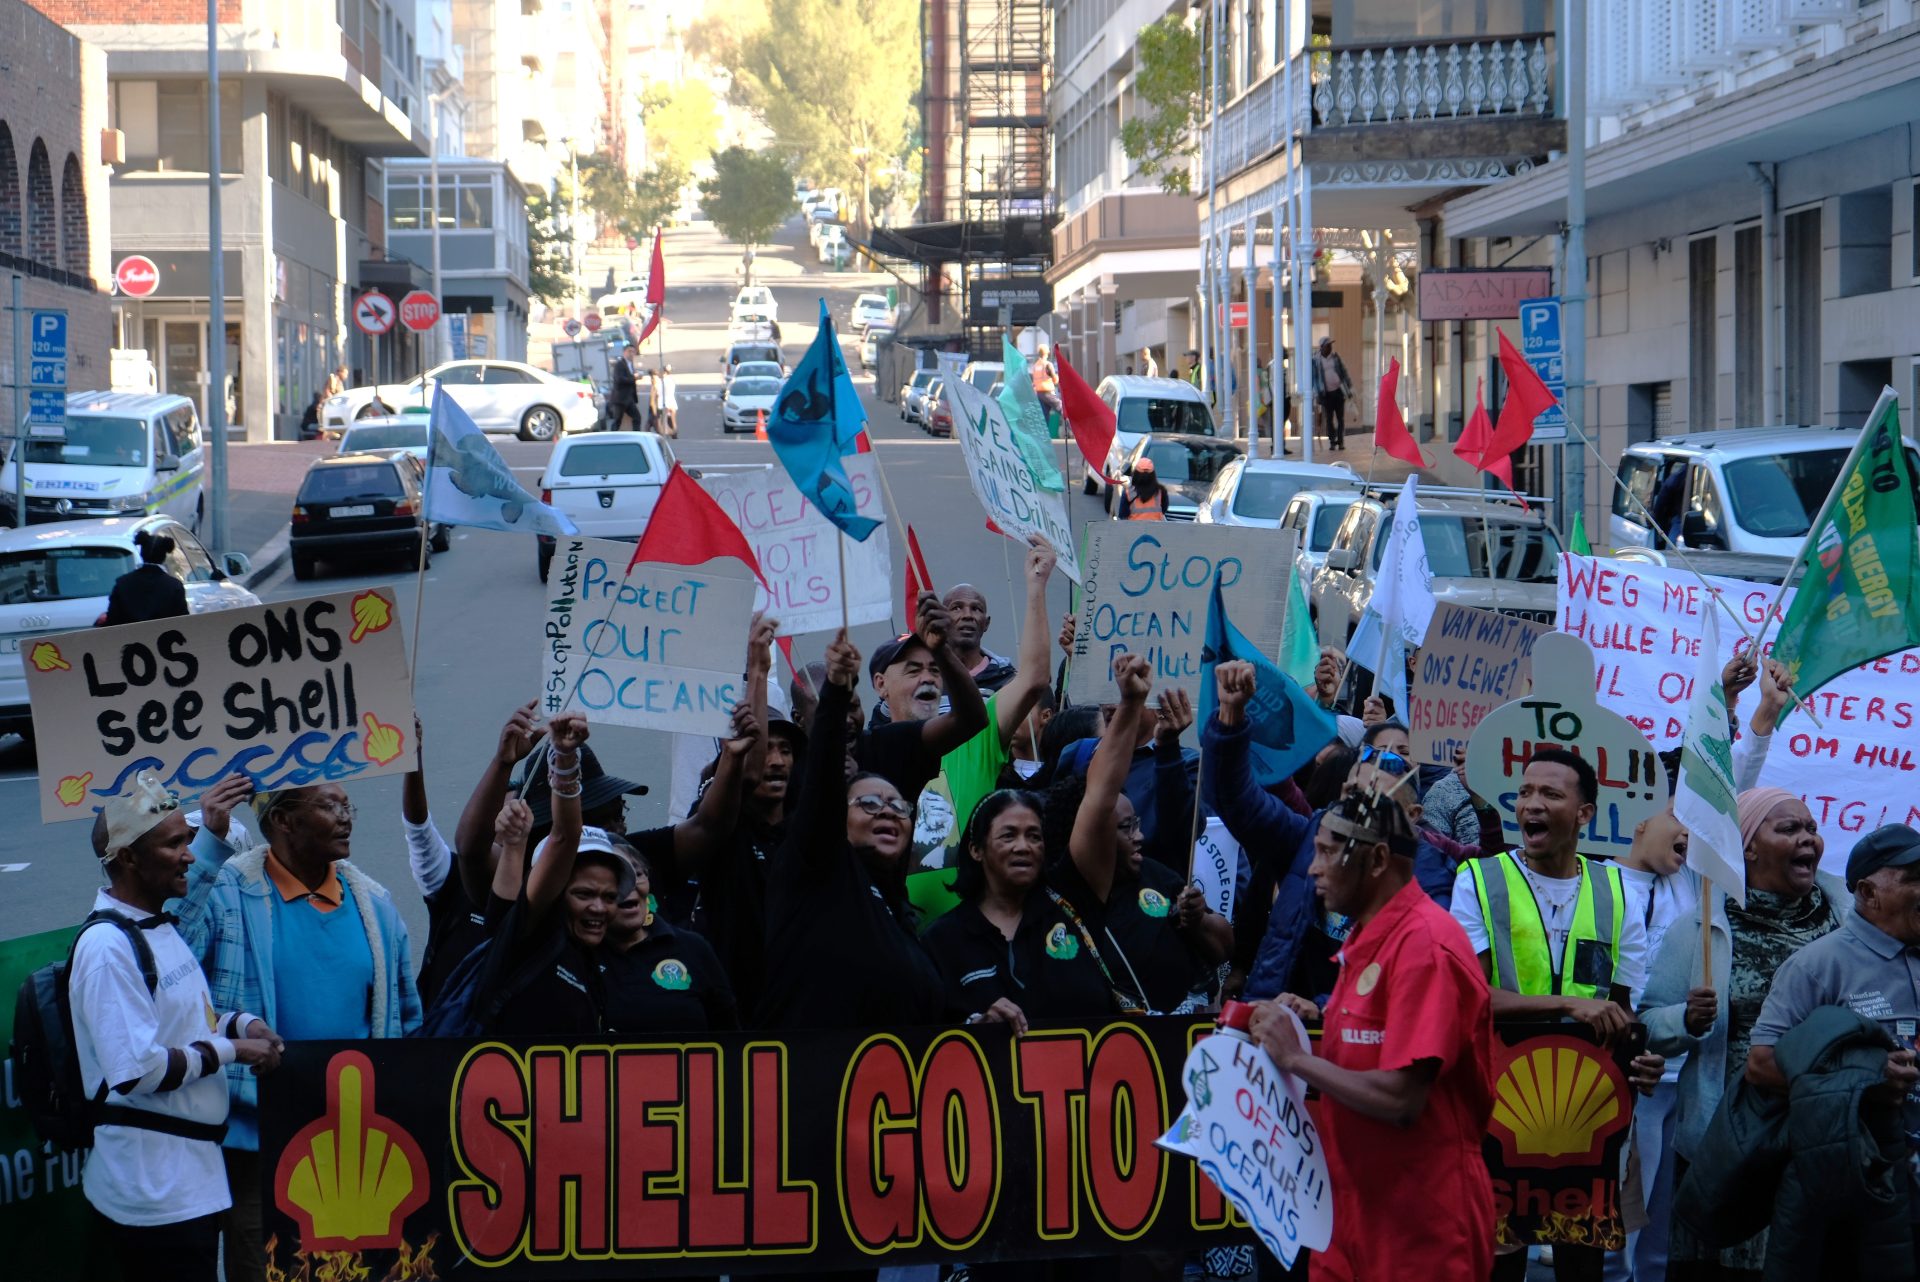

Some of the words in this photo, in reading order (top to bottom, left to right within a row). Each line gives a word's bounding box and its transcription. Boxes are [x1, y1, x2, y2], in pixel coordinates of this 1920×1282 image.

[1427, 277, 1546, 302] ABANTU
[40, 316, 59, 338] P
[404, 303, 436, 321] STOP
[1530, 308, 1551, 334] P
[32, 341, 51, 353] 120
[1524, 335, 1543, 348] 120
[1563, 552, 1640, 607] WEG
[1848, 534, 1900, 618] ENERGY
[1093, 603, 1192, 641] OCEAN
[1442, 607, 1478, 639] VAN
[1476, 614, 1520, 649] WAT
[1564, 605, 1658, 655] HULLE
[83, 629, 199, 698] LOS
[227, 600, 342, 667] ONS
[577, 668, 738, 717] OCEANS
[1423, 652, 1455, 685] ONS
[1457, 653, 1519, 700] LEWE?
[96, 690, 204, 757] see
[223, 662, 359, 741] Shell
[1436, 698, 1458, 728] DIE
[1521, 701, 1583, 741] TO
[1789, 733, 1839, 758] OM
[1206, 843, 1231, 887] STOLE
[1232, 1041, 1316, 1157] HANDS
[1235, 1088, 1286, 1150] OFF
[447, 1039, 820, 1268] SHELL
[836, 1029, 1004, 1256] GO
[1011, 1022, 1170, 1242] TO
[1209, 1122, 1301, 1242] OCEANS
[1252, 1138, 1299, 1208] OUR
[1493, 1177, 1617, 1218] Shell
